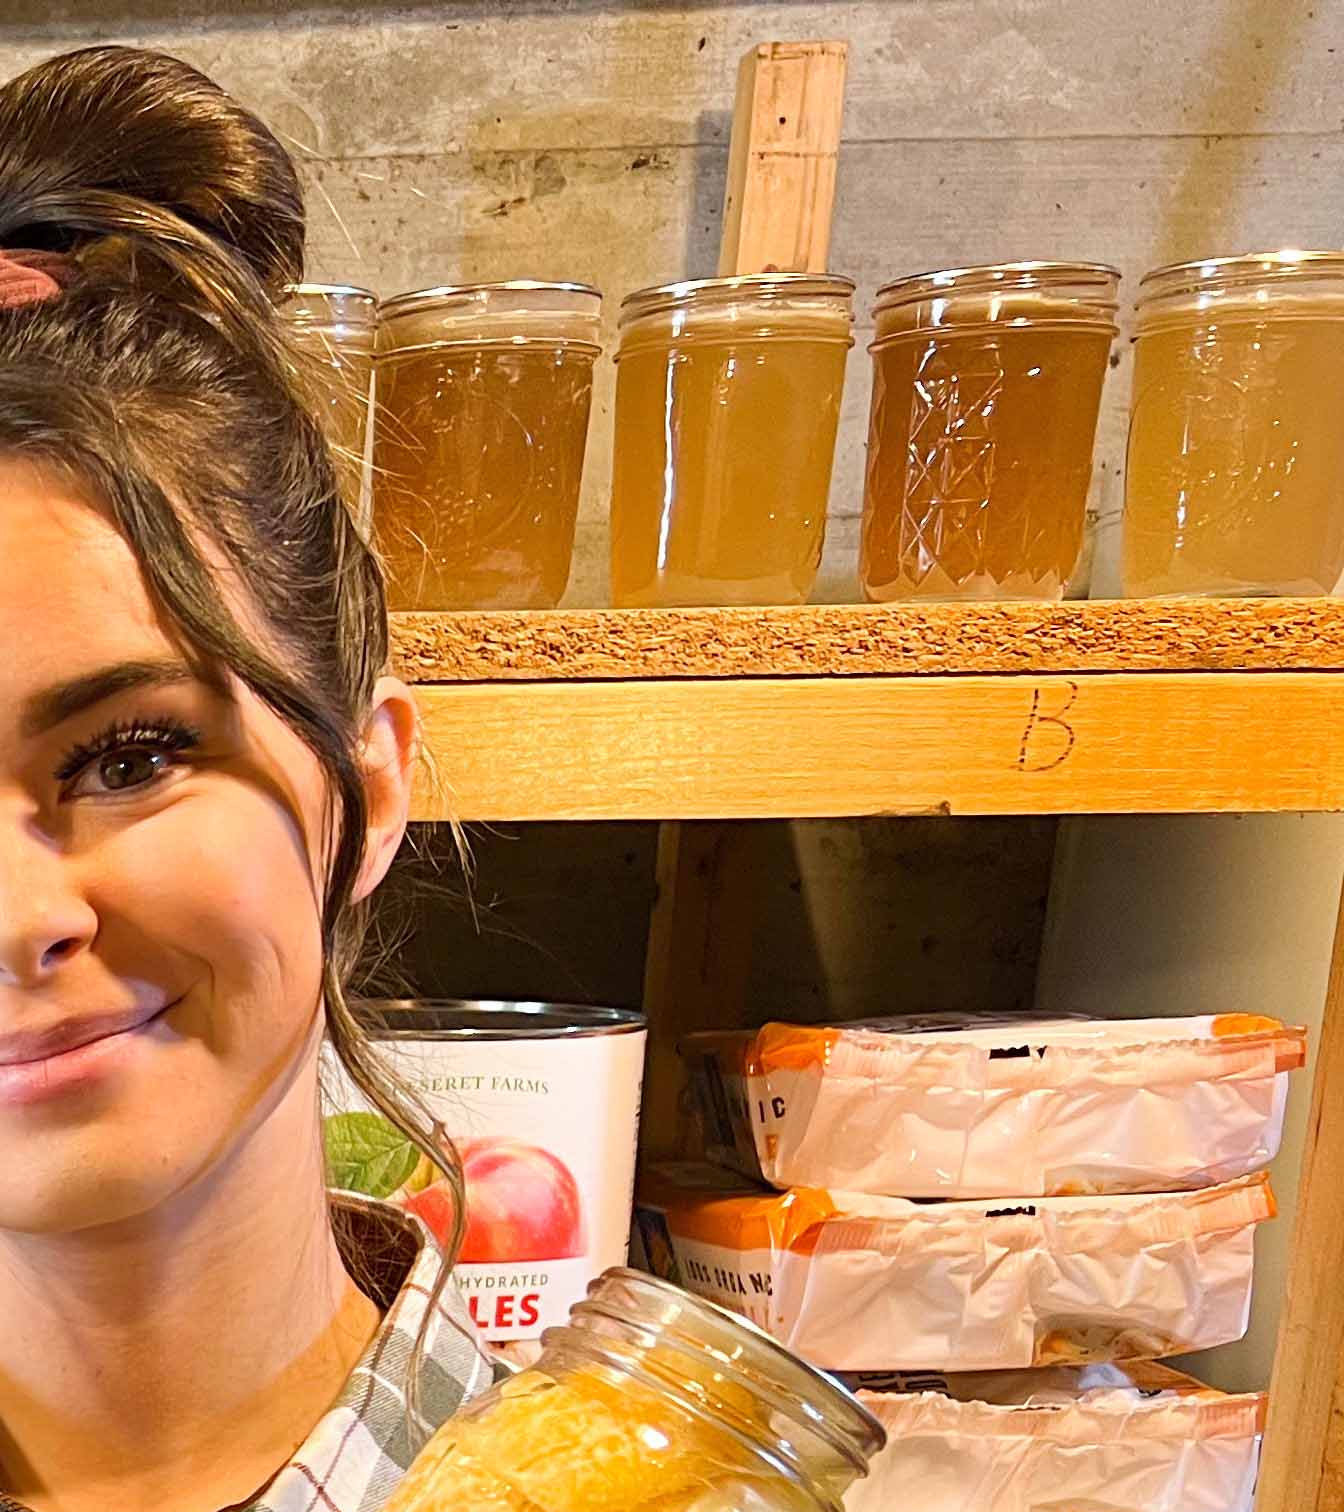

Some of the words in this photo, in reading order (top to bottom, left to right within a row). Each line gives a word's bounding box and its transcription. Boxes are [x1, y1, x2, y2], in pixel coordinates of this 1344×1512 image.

[1010, 681, 1078, 773] B
[491, 1077, 549, 1094] FARMS
[459, 1274, 549, 1288] HYDRATED
[468, 1294, 540, 1328] LES
